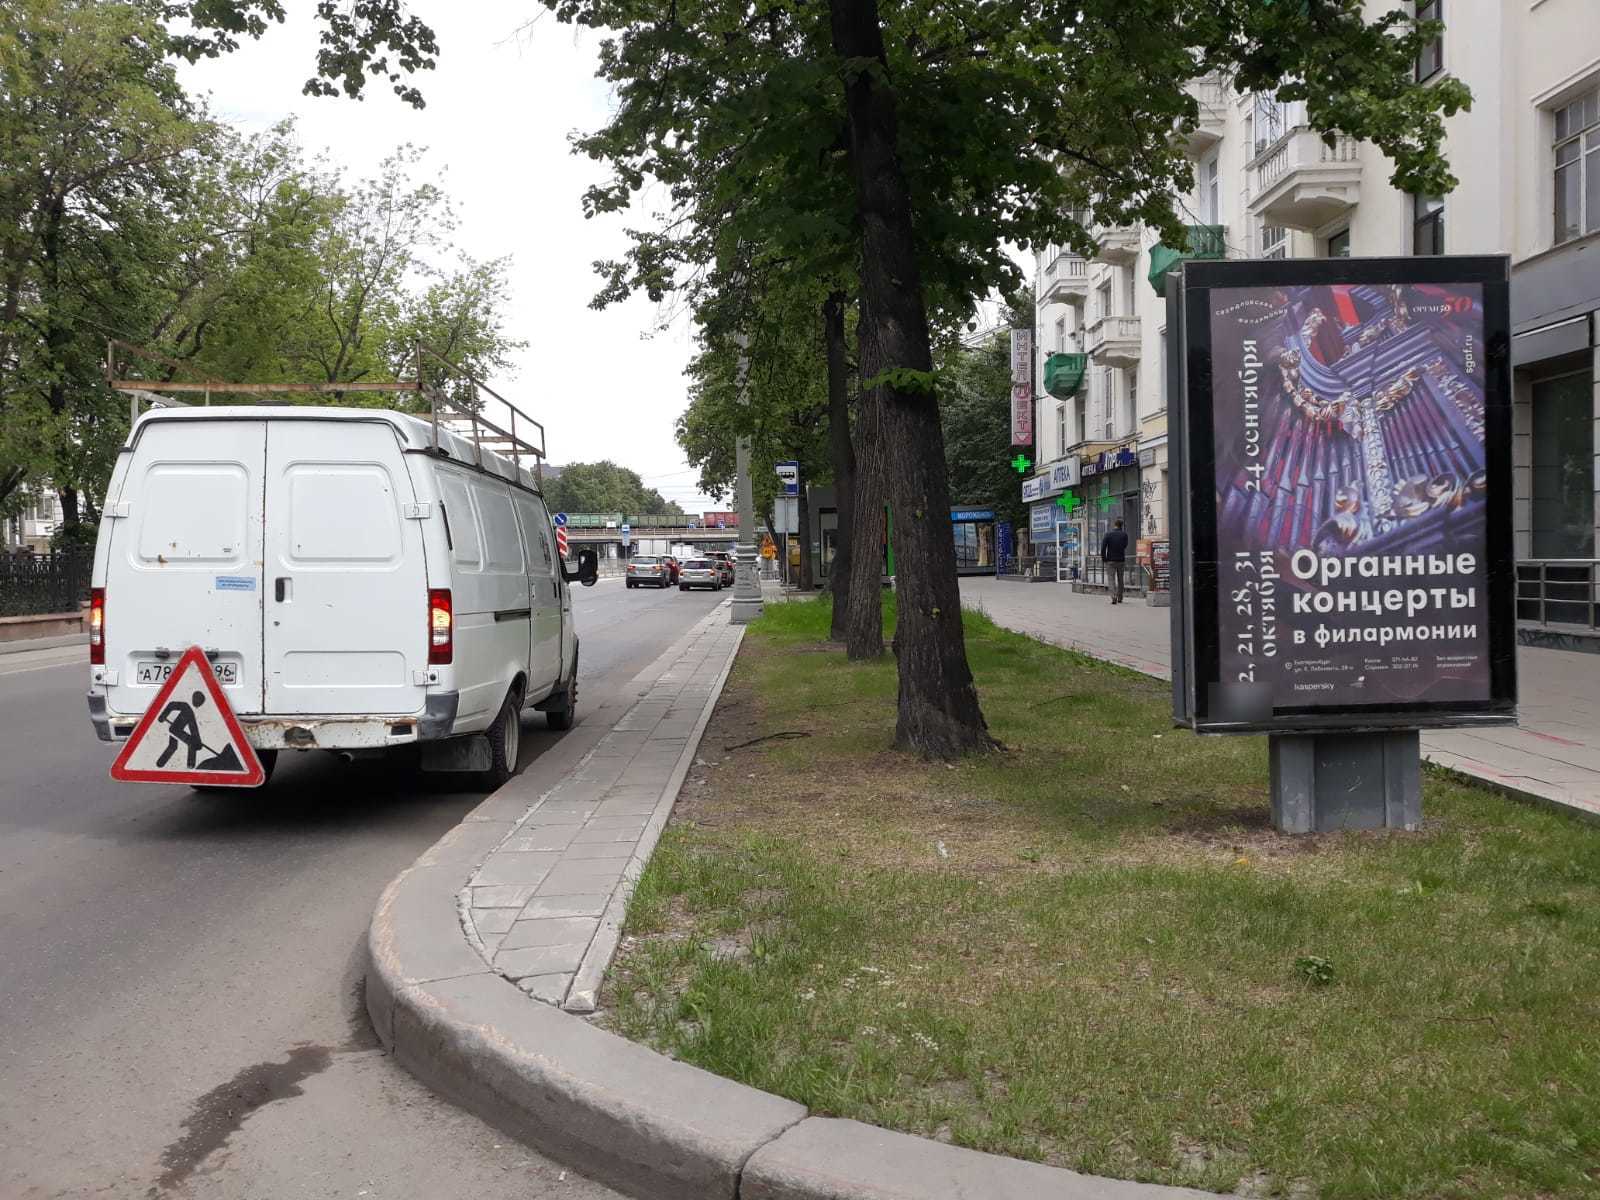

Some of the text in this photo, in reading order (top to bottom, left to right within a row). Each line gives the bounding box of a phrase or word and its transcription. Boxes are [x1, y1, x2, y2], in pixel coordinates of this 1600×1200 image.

[1462, 334, 1476, 374] sgaf.ru
[1238, 340, 1264, 492] 24 сентября
[1053, 464, 1071, 484] АПТЕКА
[1235, 552, 1256, 573] 31
[1291, 549, 1476, 586] Органные
[1232, 581, 1253, 616] 28,
[1255, 551, 1280, 657] октября
[1293, 587, 1476, 617] концерты
[1237, 624, 1255, 655] 21,
[1293, 624, 1477, 648] в филармонии
